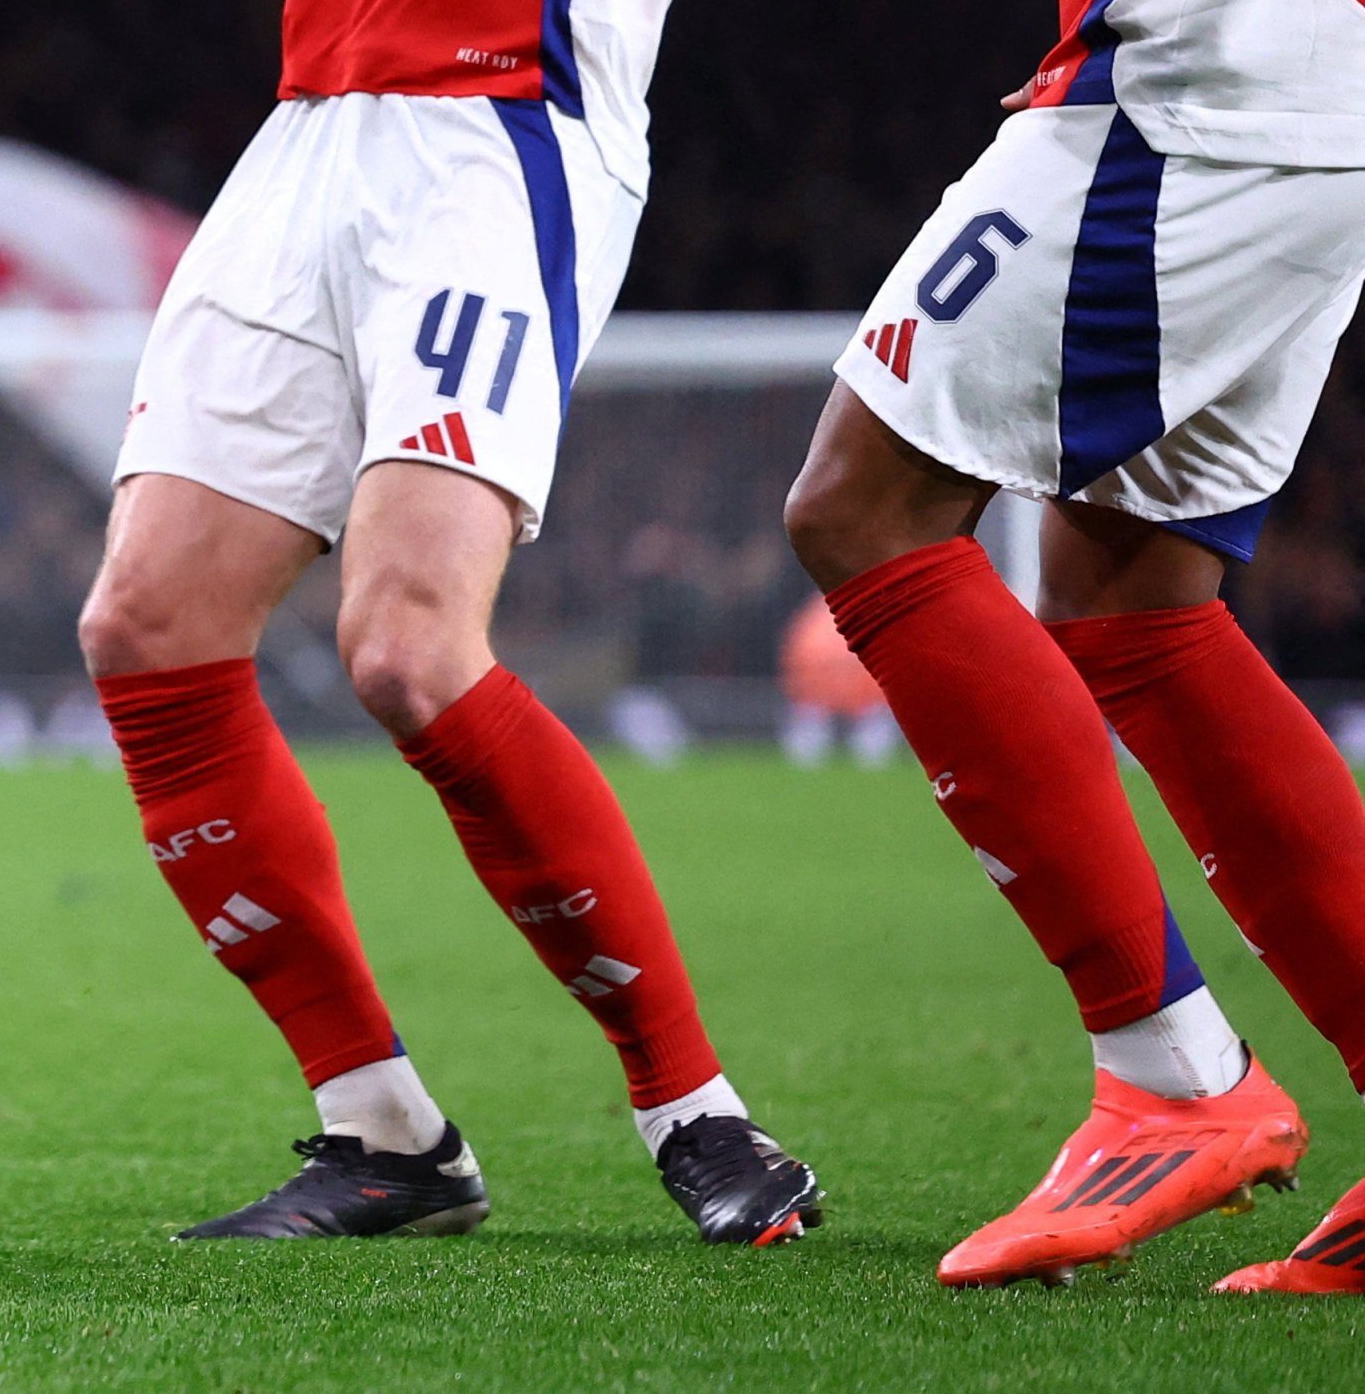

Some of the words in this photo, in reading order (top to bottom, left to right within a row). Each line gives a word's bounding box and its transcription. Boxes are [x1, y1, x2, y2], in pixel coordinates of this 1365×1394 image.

[914, 206, 1034, 325] 6
[413, 284, 531, 417] 41
[147, 818, 238, 863] AFC
[510, 887, 598, 924] AFC
